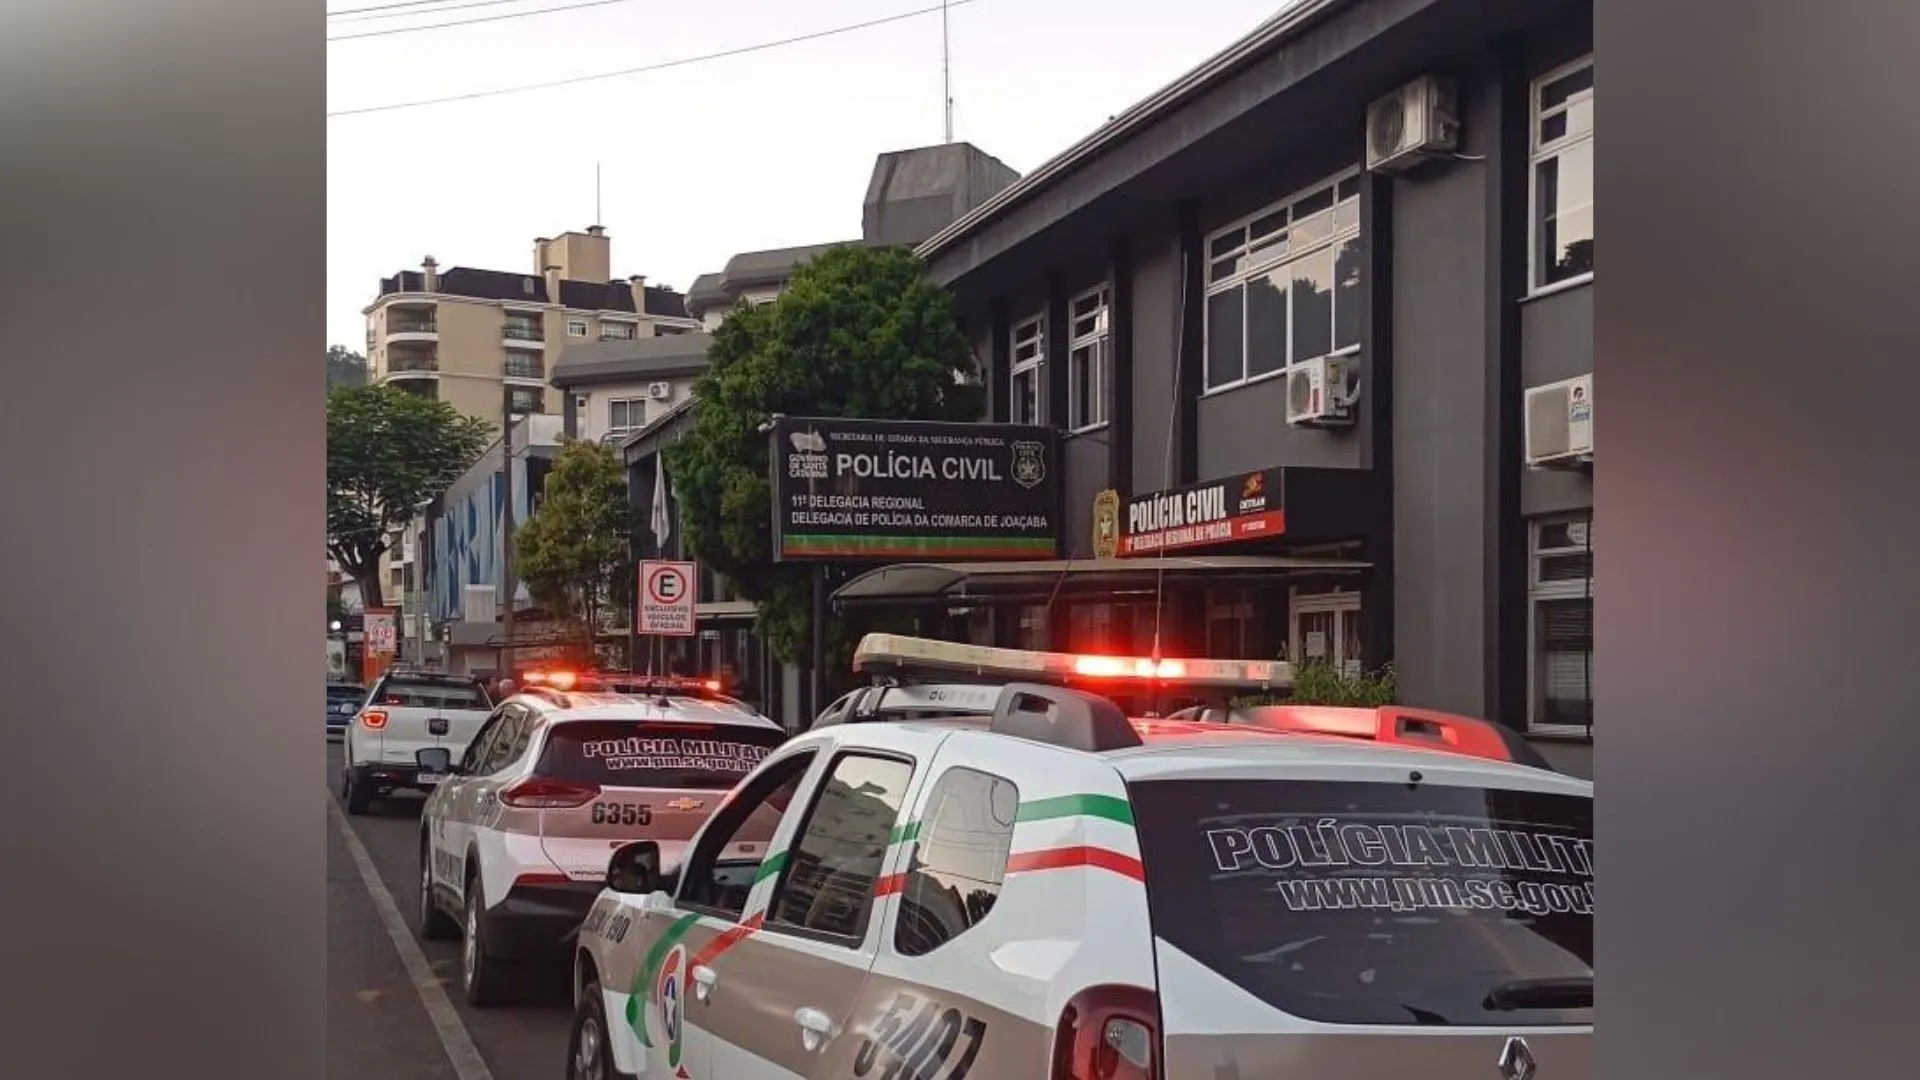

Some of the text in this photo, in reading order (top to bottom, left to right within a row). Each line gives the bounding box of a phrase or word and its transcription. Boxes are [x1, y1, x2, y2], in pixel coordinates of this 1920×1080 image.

[836, 449, 1003, 480] POLÍCIA CIVIL
[809, 494, 870, 508] DELEGACIA
[871, 496, 925, 510] REGIONAL
[1129, 486, 1227, 534] POLÍCIA CIVIL
[791, 511, 1047, 530] DELEGACIA DE POLÍCIA DA COMARCA DE JOAÇABA
[659, 574, 677, 597] E
[582, 736, 681, 758] POLÍCIA
[591, 801, 653, 827] 6355
[1207, 817, 1447, 871] POLÍCIA
